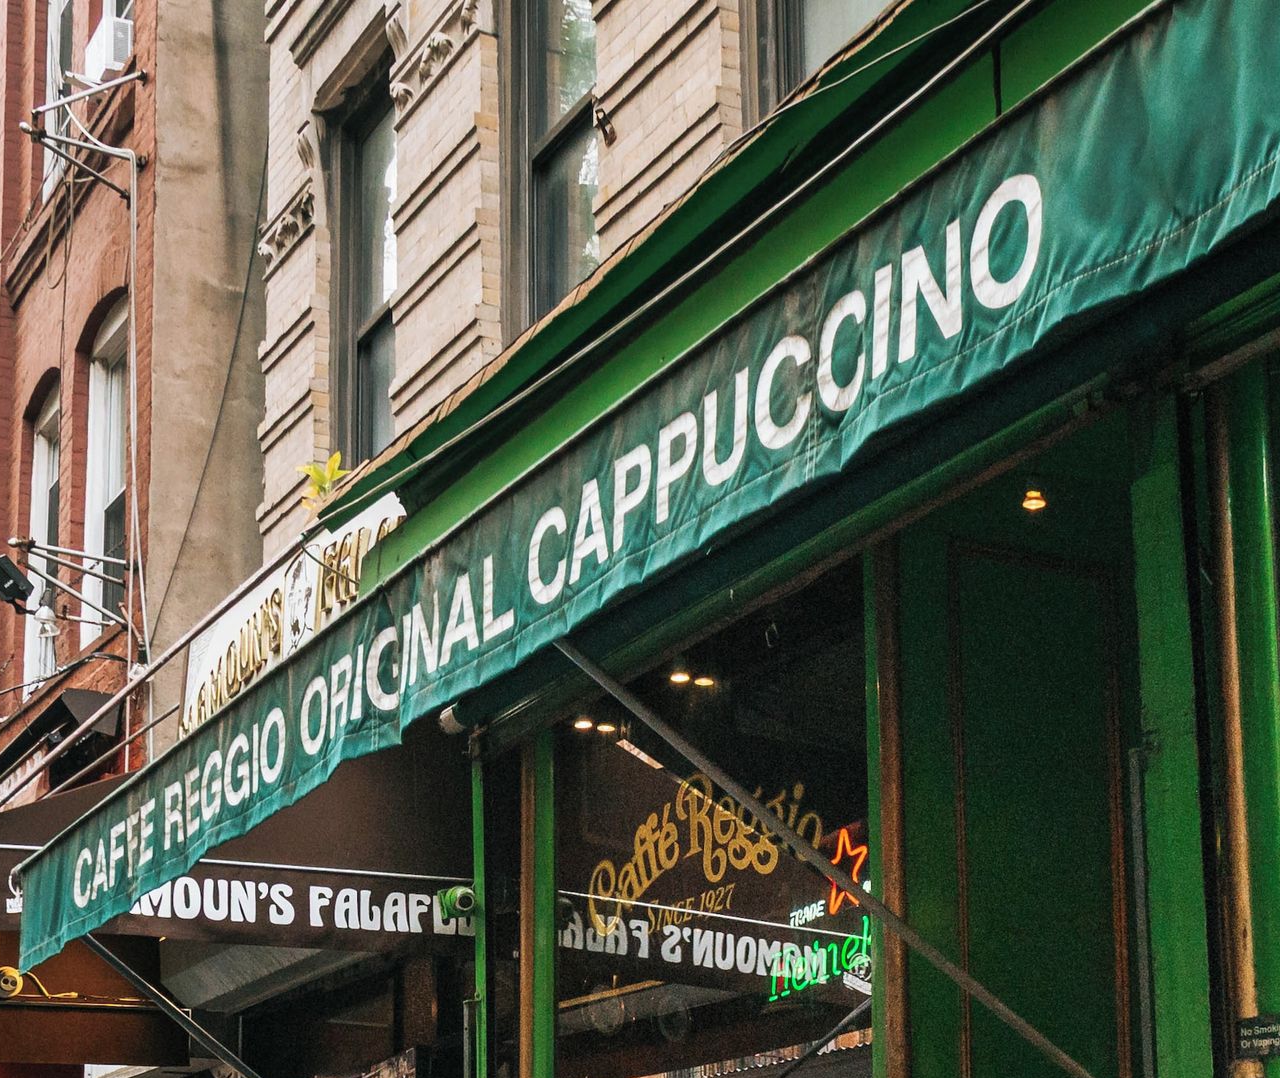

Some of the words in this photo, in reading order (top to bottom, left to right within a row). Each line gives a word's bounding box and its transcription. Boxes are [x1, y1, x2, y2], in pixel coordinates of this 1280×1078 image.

[73, 798, 154, 909] CAFFE
[163, 706, 286, 855] REGGIO
[300, 556, 515, 756] ORIGINAL
[527, 173, 1043, 605] CAPPUCCINO
[129, 876, 295, 925] MOUN'S
[648, 896, 694, 934] SINCE
[700, 883, 736, 918] 1927
[1240, 1027, 1252, 1037] No
[1240, 1040, 1251, 1049] Or
